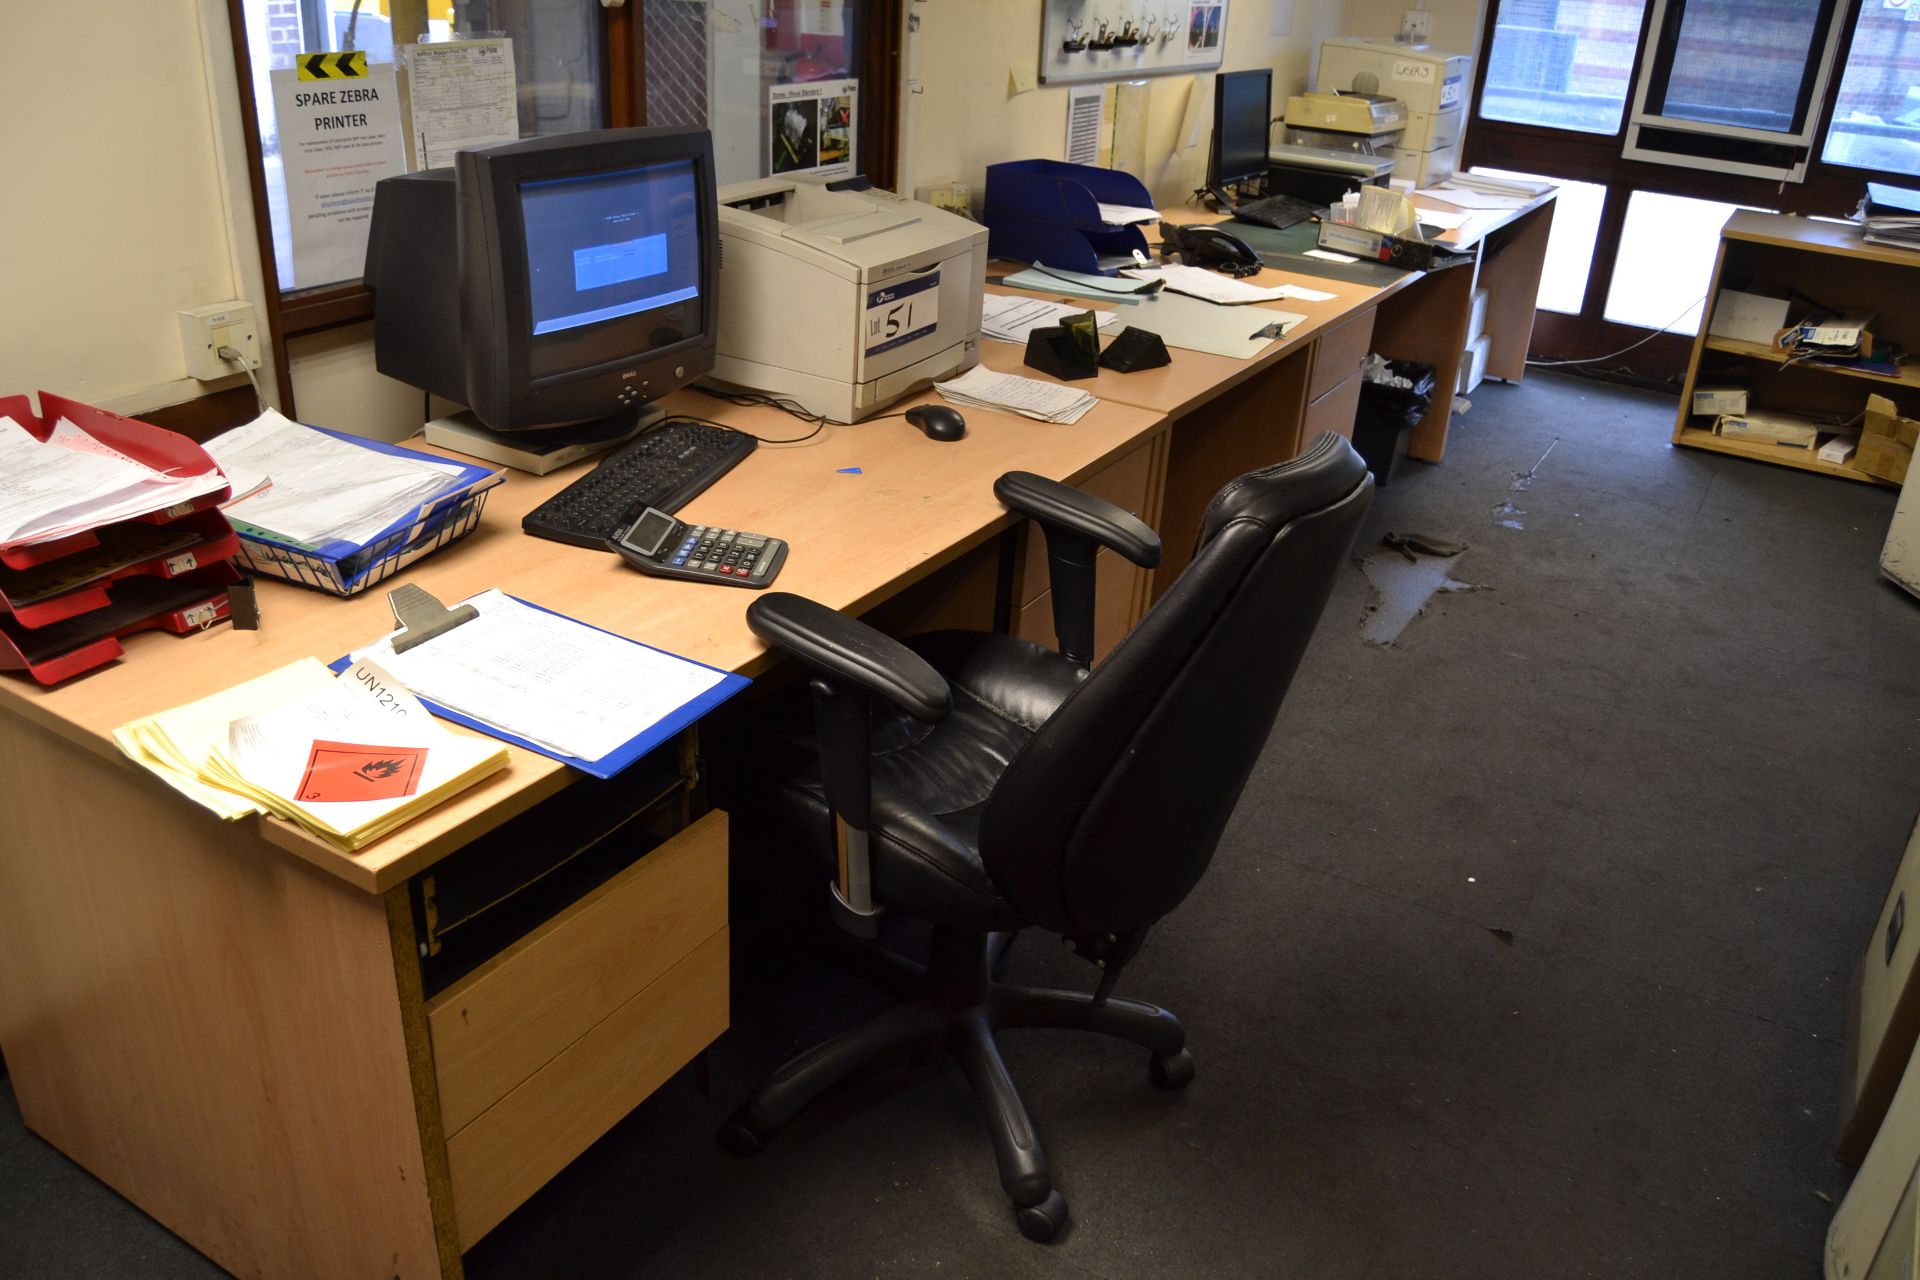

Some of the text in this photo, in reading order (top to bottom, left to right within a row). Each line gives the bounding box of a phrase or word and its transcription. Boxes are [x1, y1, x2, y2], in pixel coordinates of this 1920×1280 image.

[295, 88, 379, 107] SPARE ZEBRA
[314, 113, 368, 130] PRINTER
[870, 302, 913, 338] Lot 51
